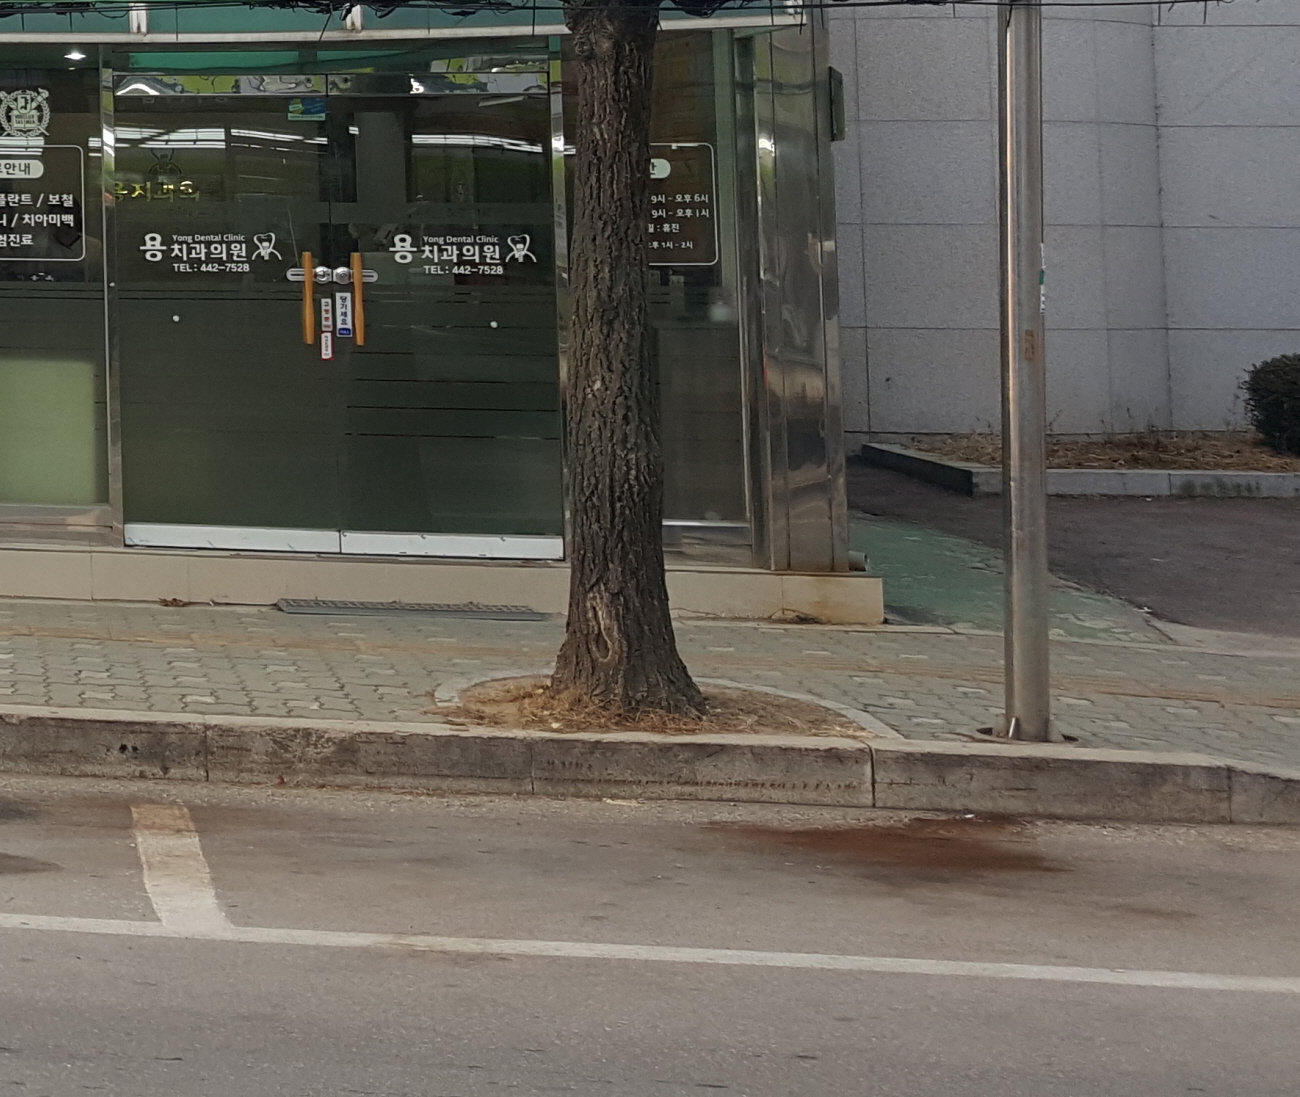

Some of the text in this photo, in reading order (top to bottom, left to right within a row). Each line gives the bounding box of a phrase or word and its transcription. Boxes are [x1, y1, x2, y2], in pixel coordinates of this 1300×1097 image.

[48, 193, 75, 207] 보철
[22, 214, 75, 227] 치아미백
[172, 234, 246, 243] Yong Dental Clinic
[423, 235, 499, 244] Yong Dental Clinic
[200, 263, 250, 272] 442-7528
[452, 265, 504, 274] 442-7528
